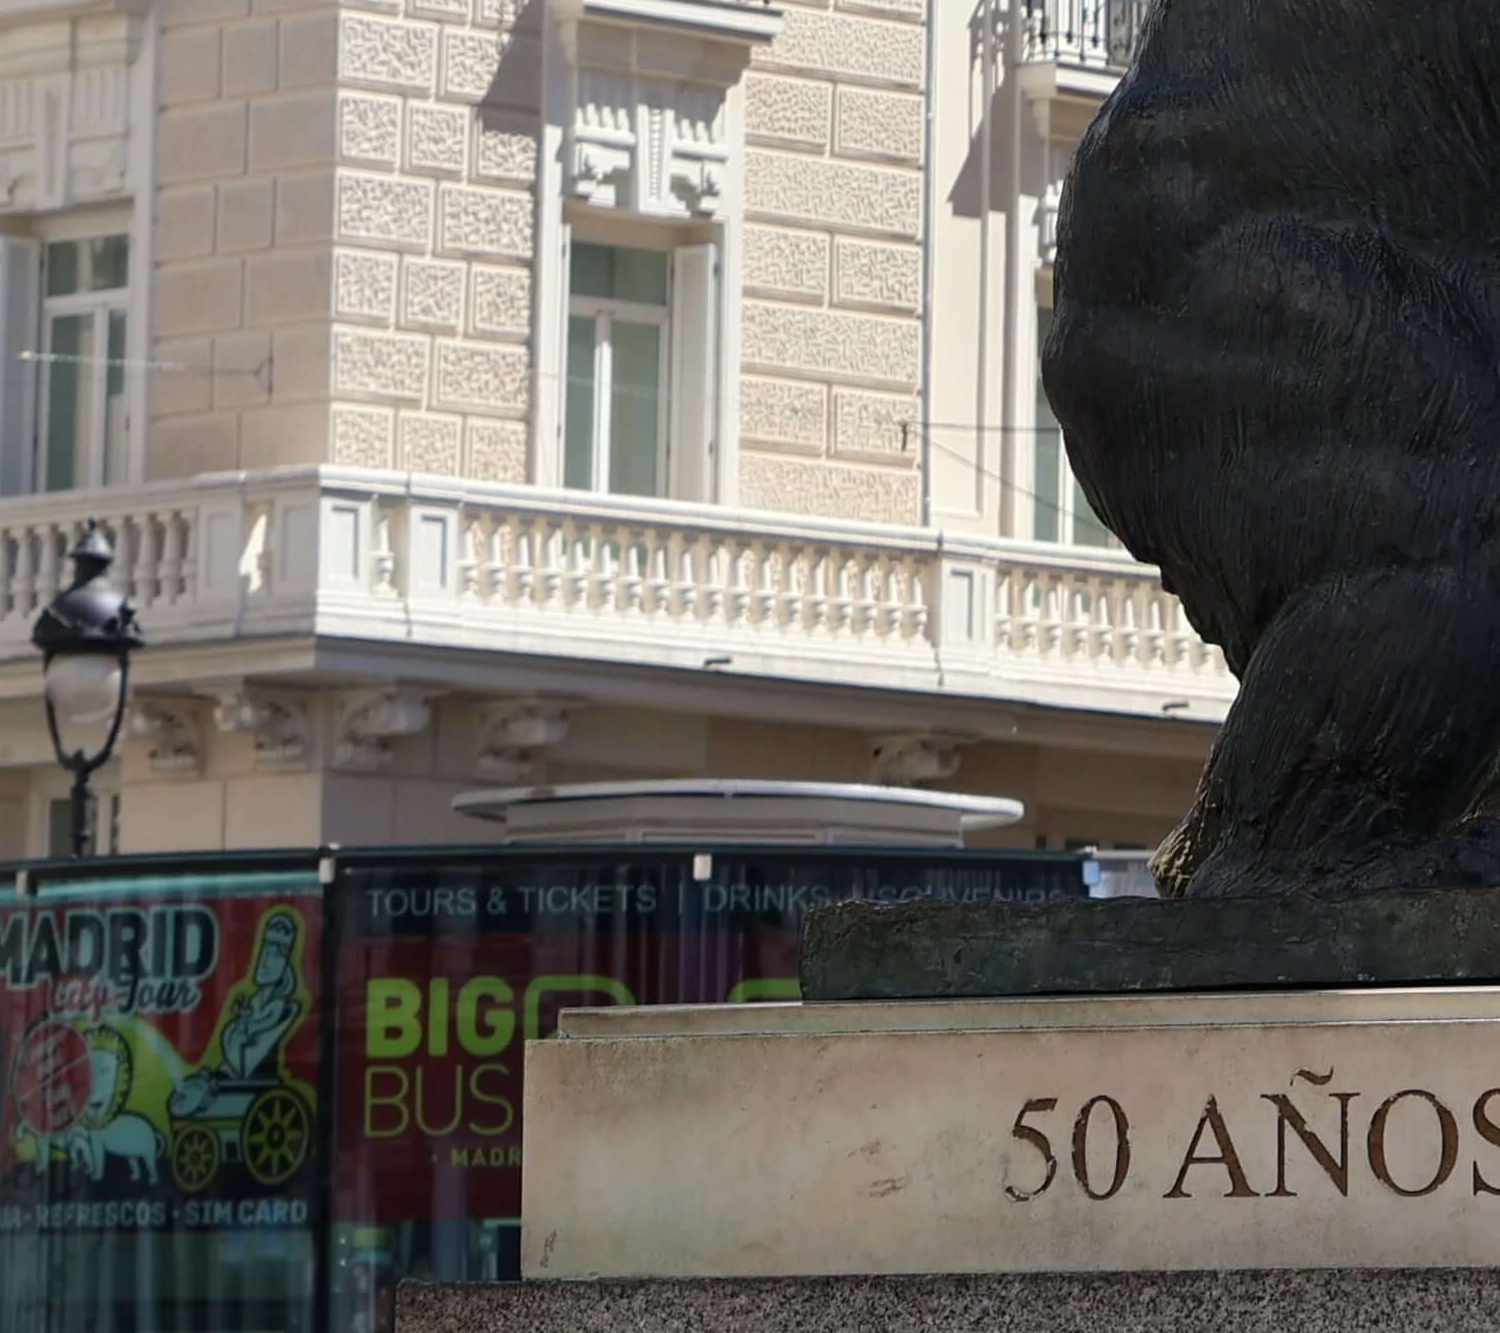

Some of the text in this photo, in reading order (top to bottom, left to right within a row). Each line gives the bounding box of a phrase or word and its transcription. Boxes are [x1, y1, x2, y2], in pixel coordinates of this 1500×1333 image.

[366, 886, 477, 918] TOURS
[487, 888, 508, 915] &
[519, 884, 657, 915] TICKETS
[703, 883, 829, 914] DRINKS
[114, 973, 203, 1014] Tour
[365, 974, 516, 1059] BIG
[363, 1063, 514, 1137] BUS
[1002, 1094, 1132, 1202] 50
[35, 1200, 165, 1228] REFRESCOS
[185, 1200, 232, 1225] SIM
[237, 1198, 308, 1225] CARD
